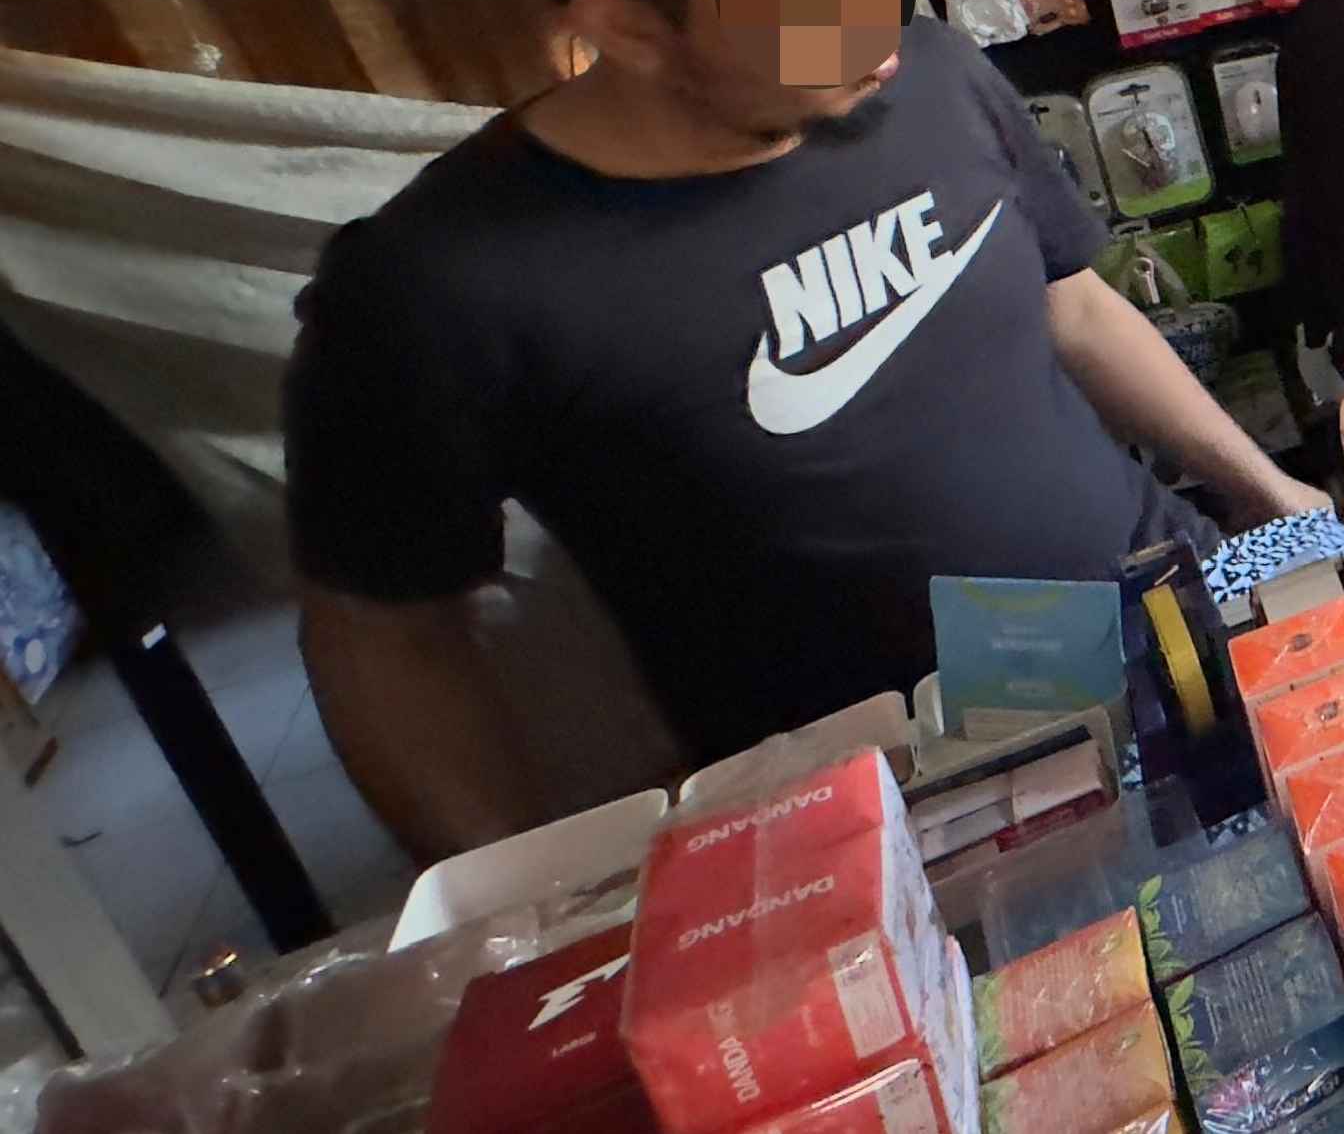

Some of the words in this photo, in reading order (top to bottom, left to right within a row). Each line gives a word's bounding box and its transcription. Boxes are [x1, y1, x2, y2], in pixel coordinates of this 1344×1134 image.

[760, 191, 953, 361] NIKE
[686, 785, 833, 854] DANDANG
[676, 874, 835, 952] DANDANG
